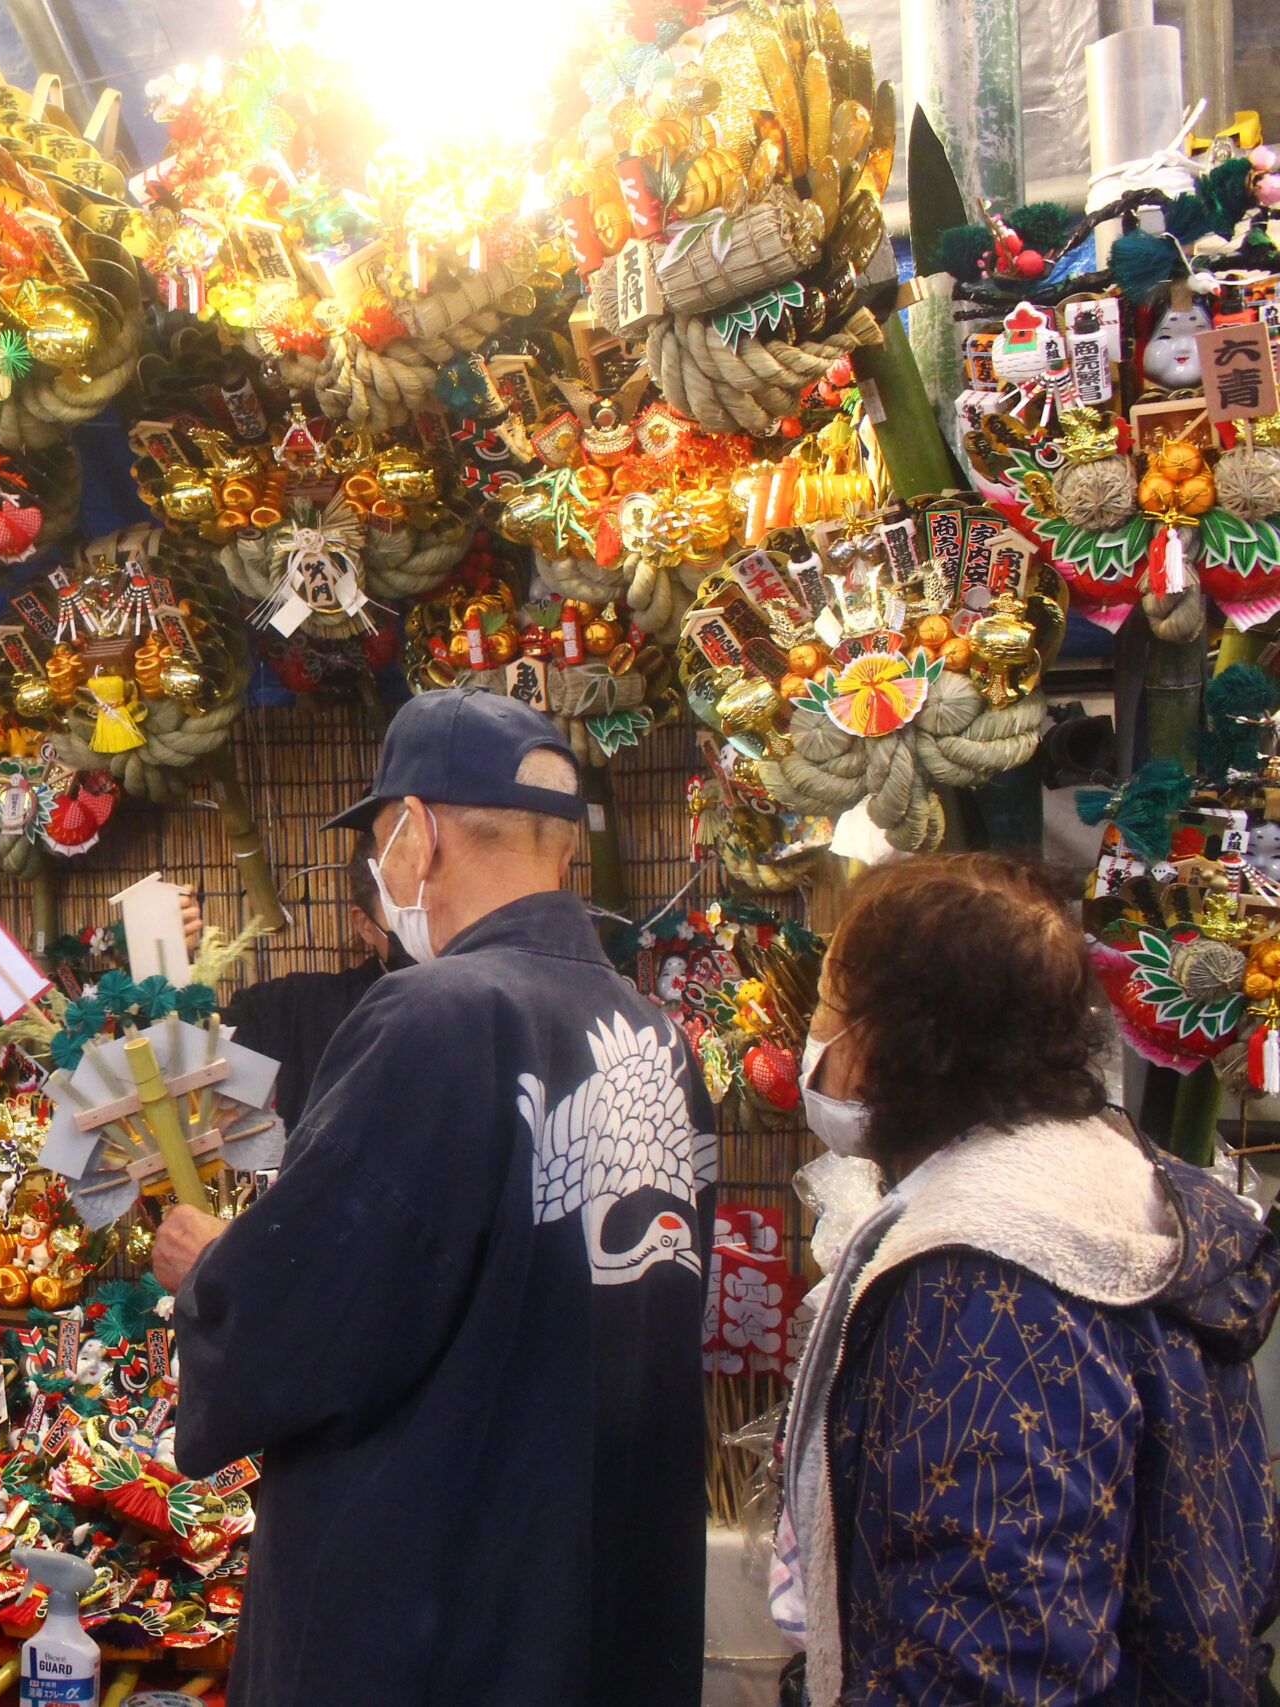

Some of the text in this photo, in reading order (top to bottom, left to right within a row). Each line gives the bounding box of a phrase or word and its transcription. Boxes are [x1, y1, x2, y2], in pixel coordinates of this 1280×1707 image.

[1074, 340, 1102, 402] 商売繁昌
[1214, 339, 1262, 409] 六青
[305, 560, 332, 602] 笑門
[989, 548, 1024, 598] 家内
[39, 1660, 73, 1675] GUARD
